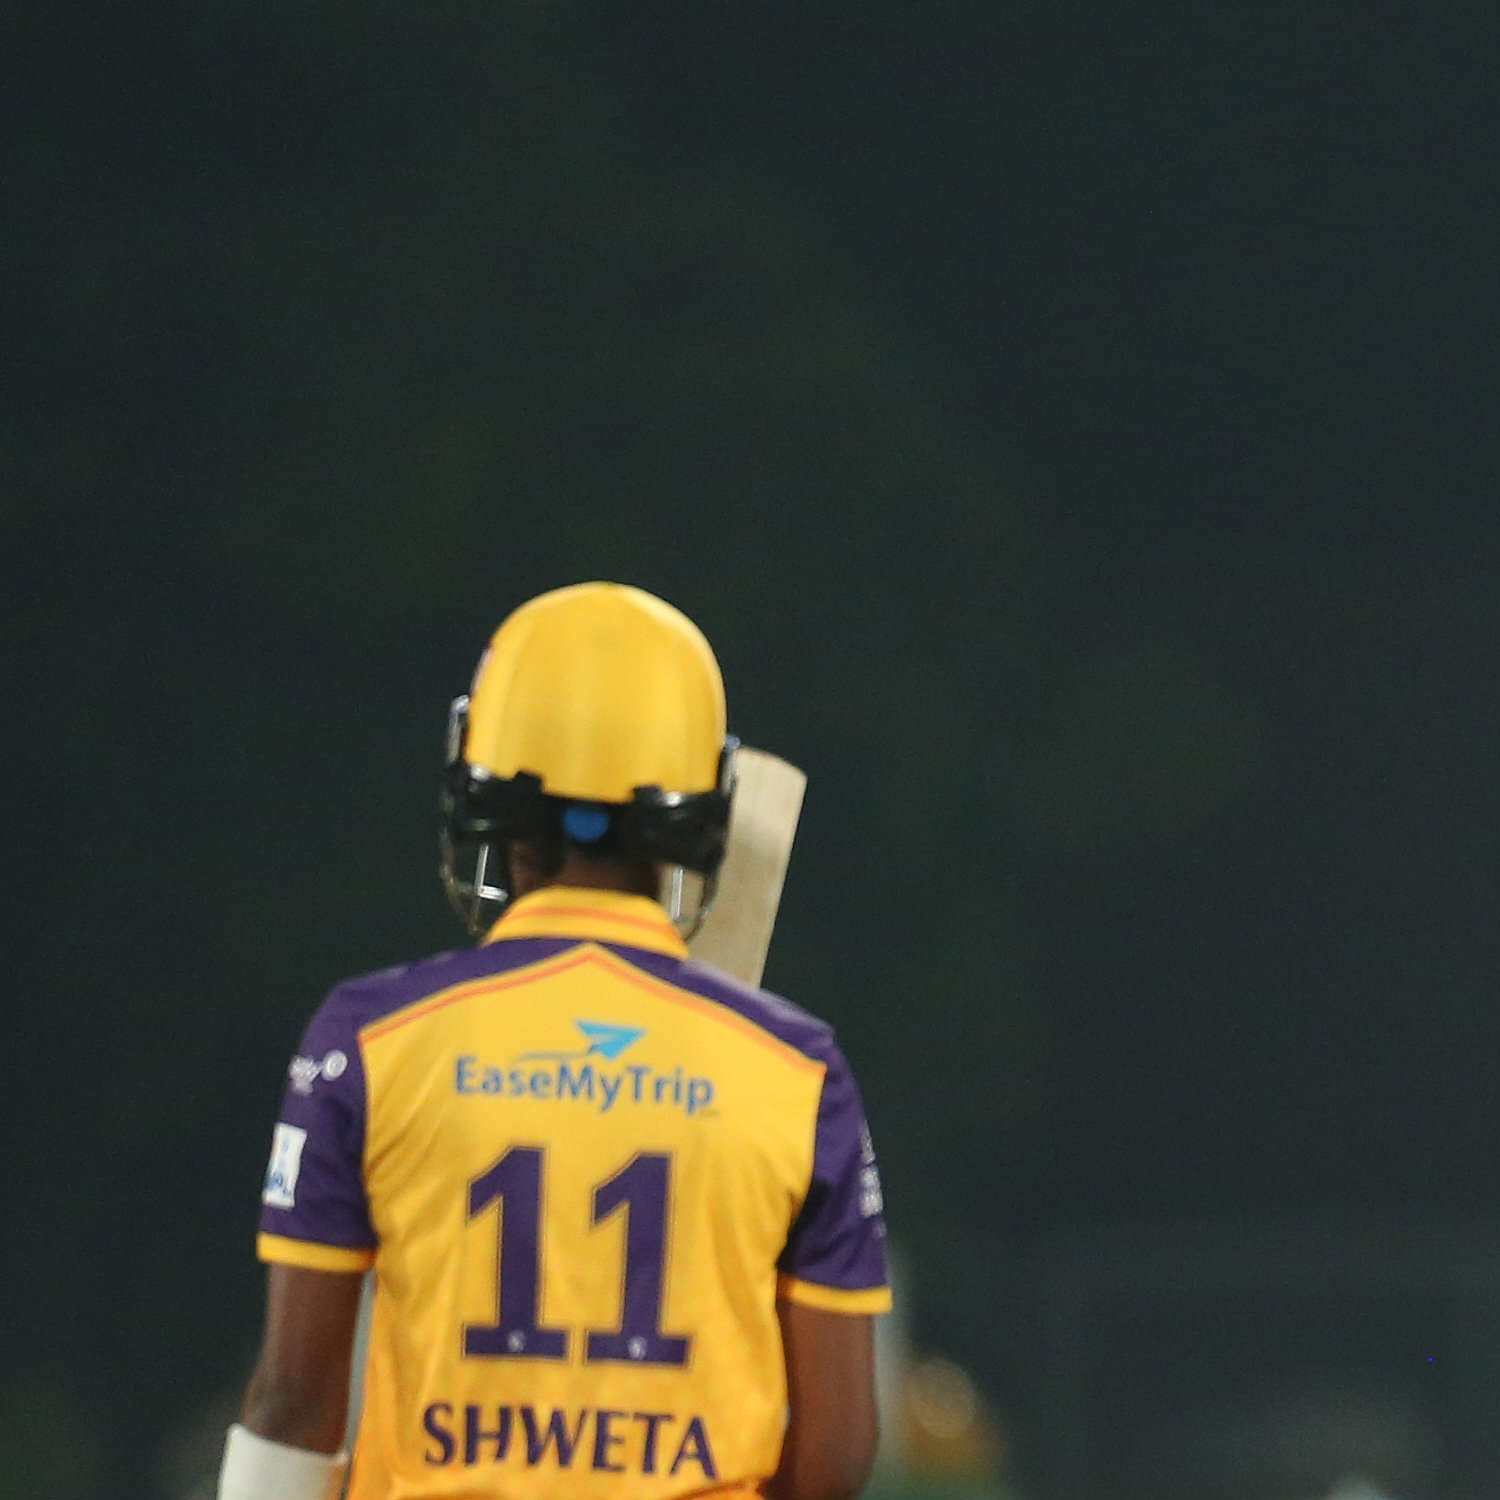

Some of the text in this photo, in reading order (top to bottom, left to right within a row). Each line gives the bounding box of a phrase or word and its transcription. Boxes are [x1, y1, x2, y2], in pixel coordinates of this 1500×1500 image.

[456, 1055, 714, 1116] EaseMyTrip
[462, 1143, 694, 1370] 11
[423, 1402, 717, 1480] SHWETA
